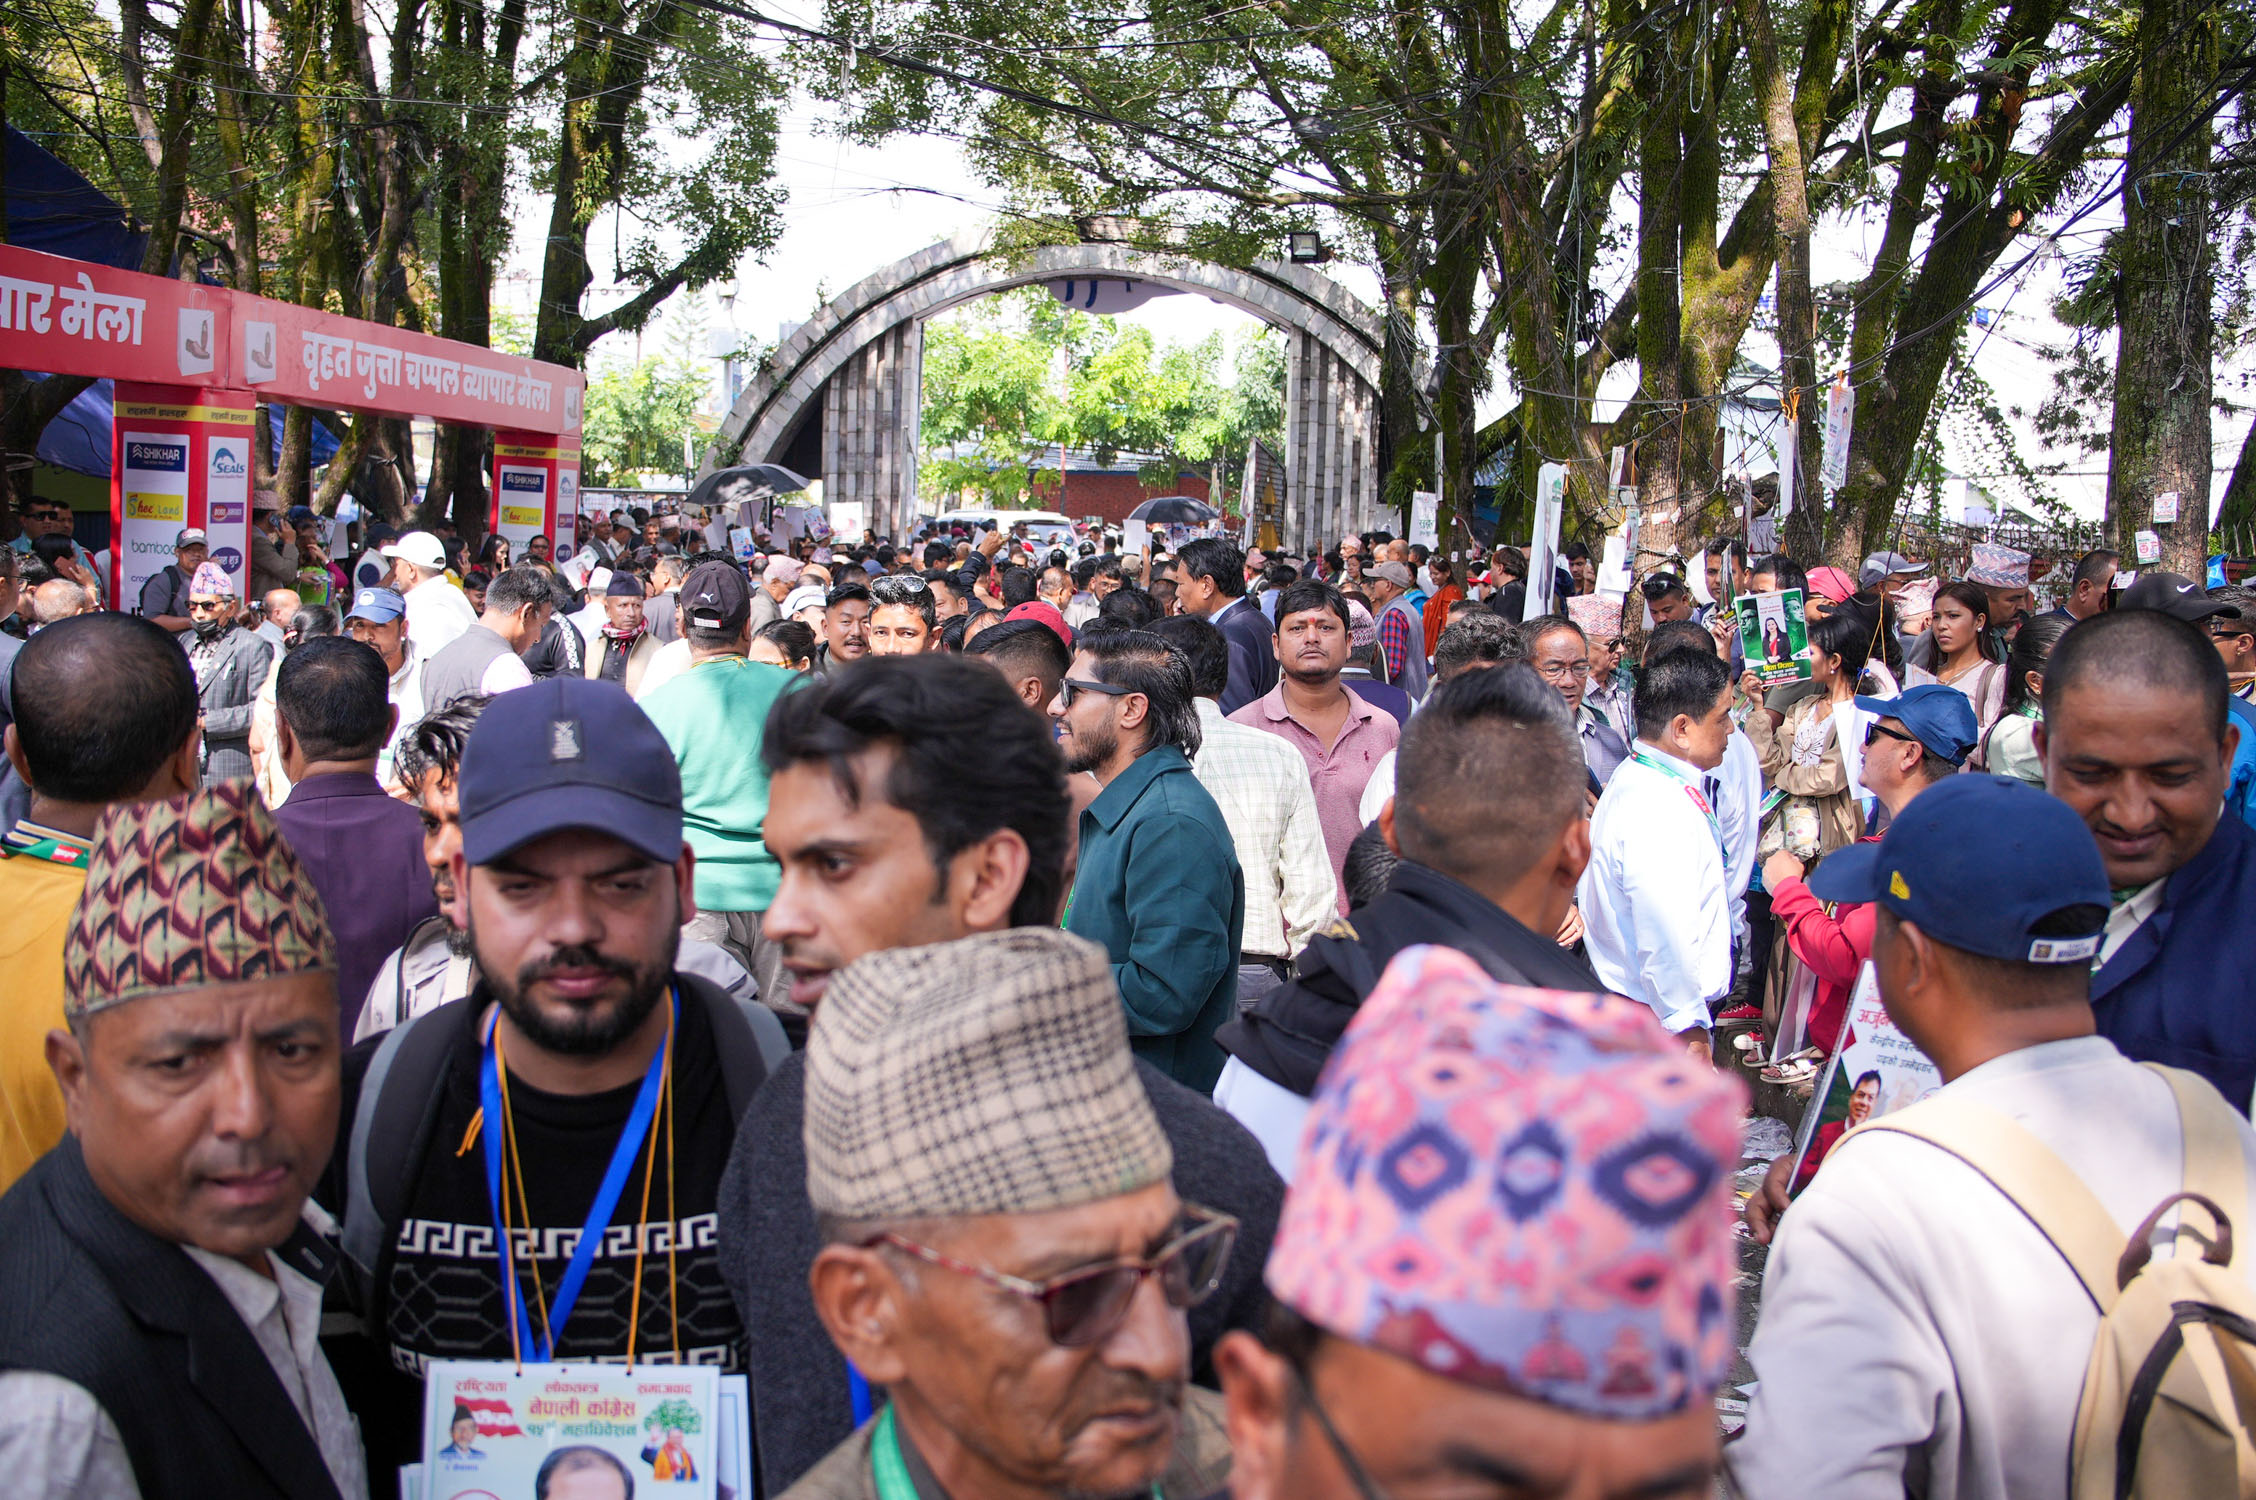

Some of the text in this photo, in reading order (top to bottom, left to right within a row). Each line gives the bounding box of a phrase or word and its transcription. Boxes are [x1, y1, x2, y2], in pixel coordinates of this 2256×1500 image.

[60, 272, 146, 345] मेला
[302, 330, 551, 413] वृहत जुत्ता चप्पल व्यापार मेला
[143, 447, 181, 462] SHIKHAR
[529, 1395, 636, 1418] नेपाली कांग्रेस
